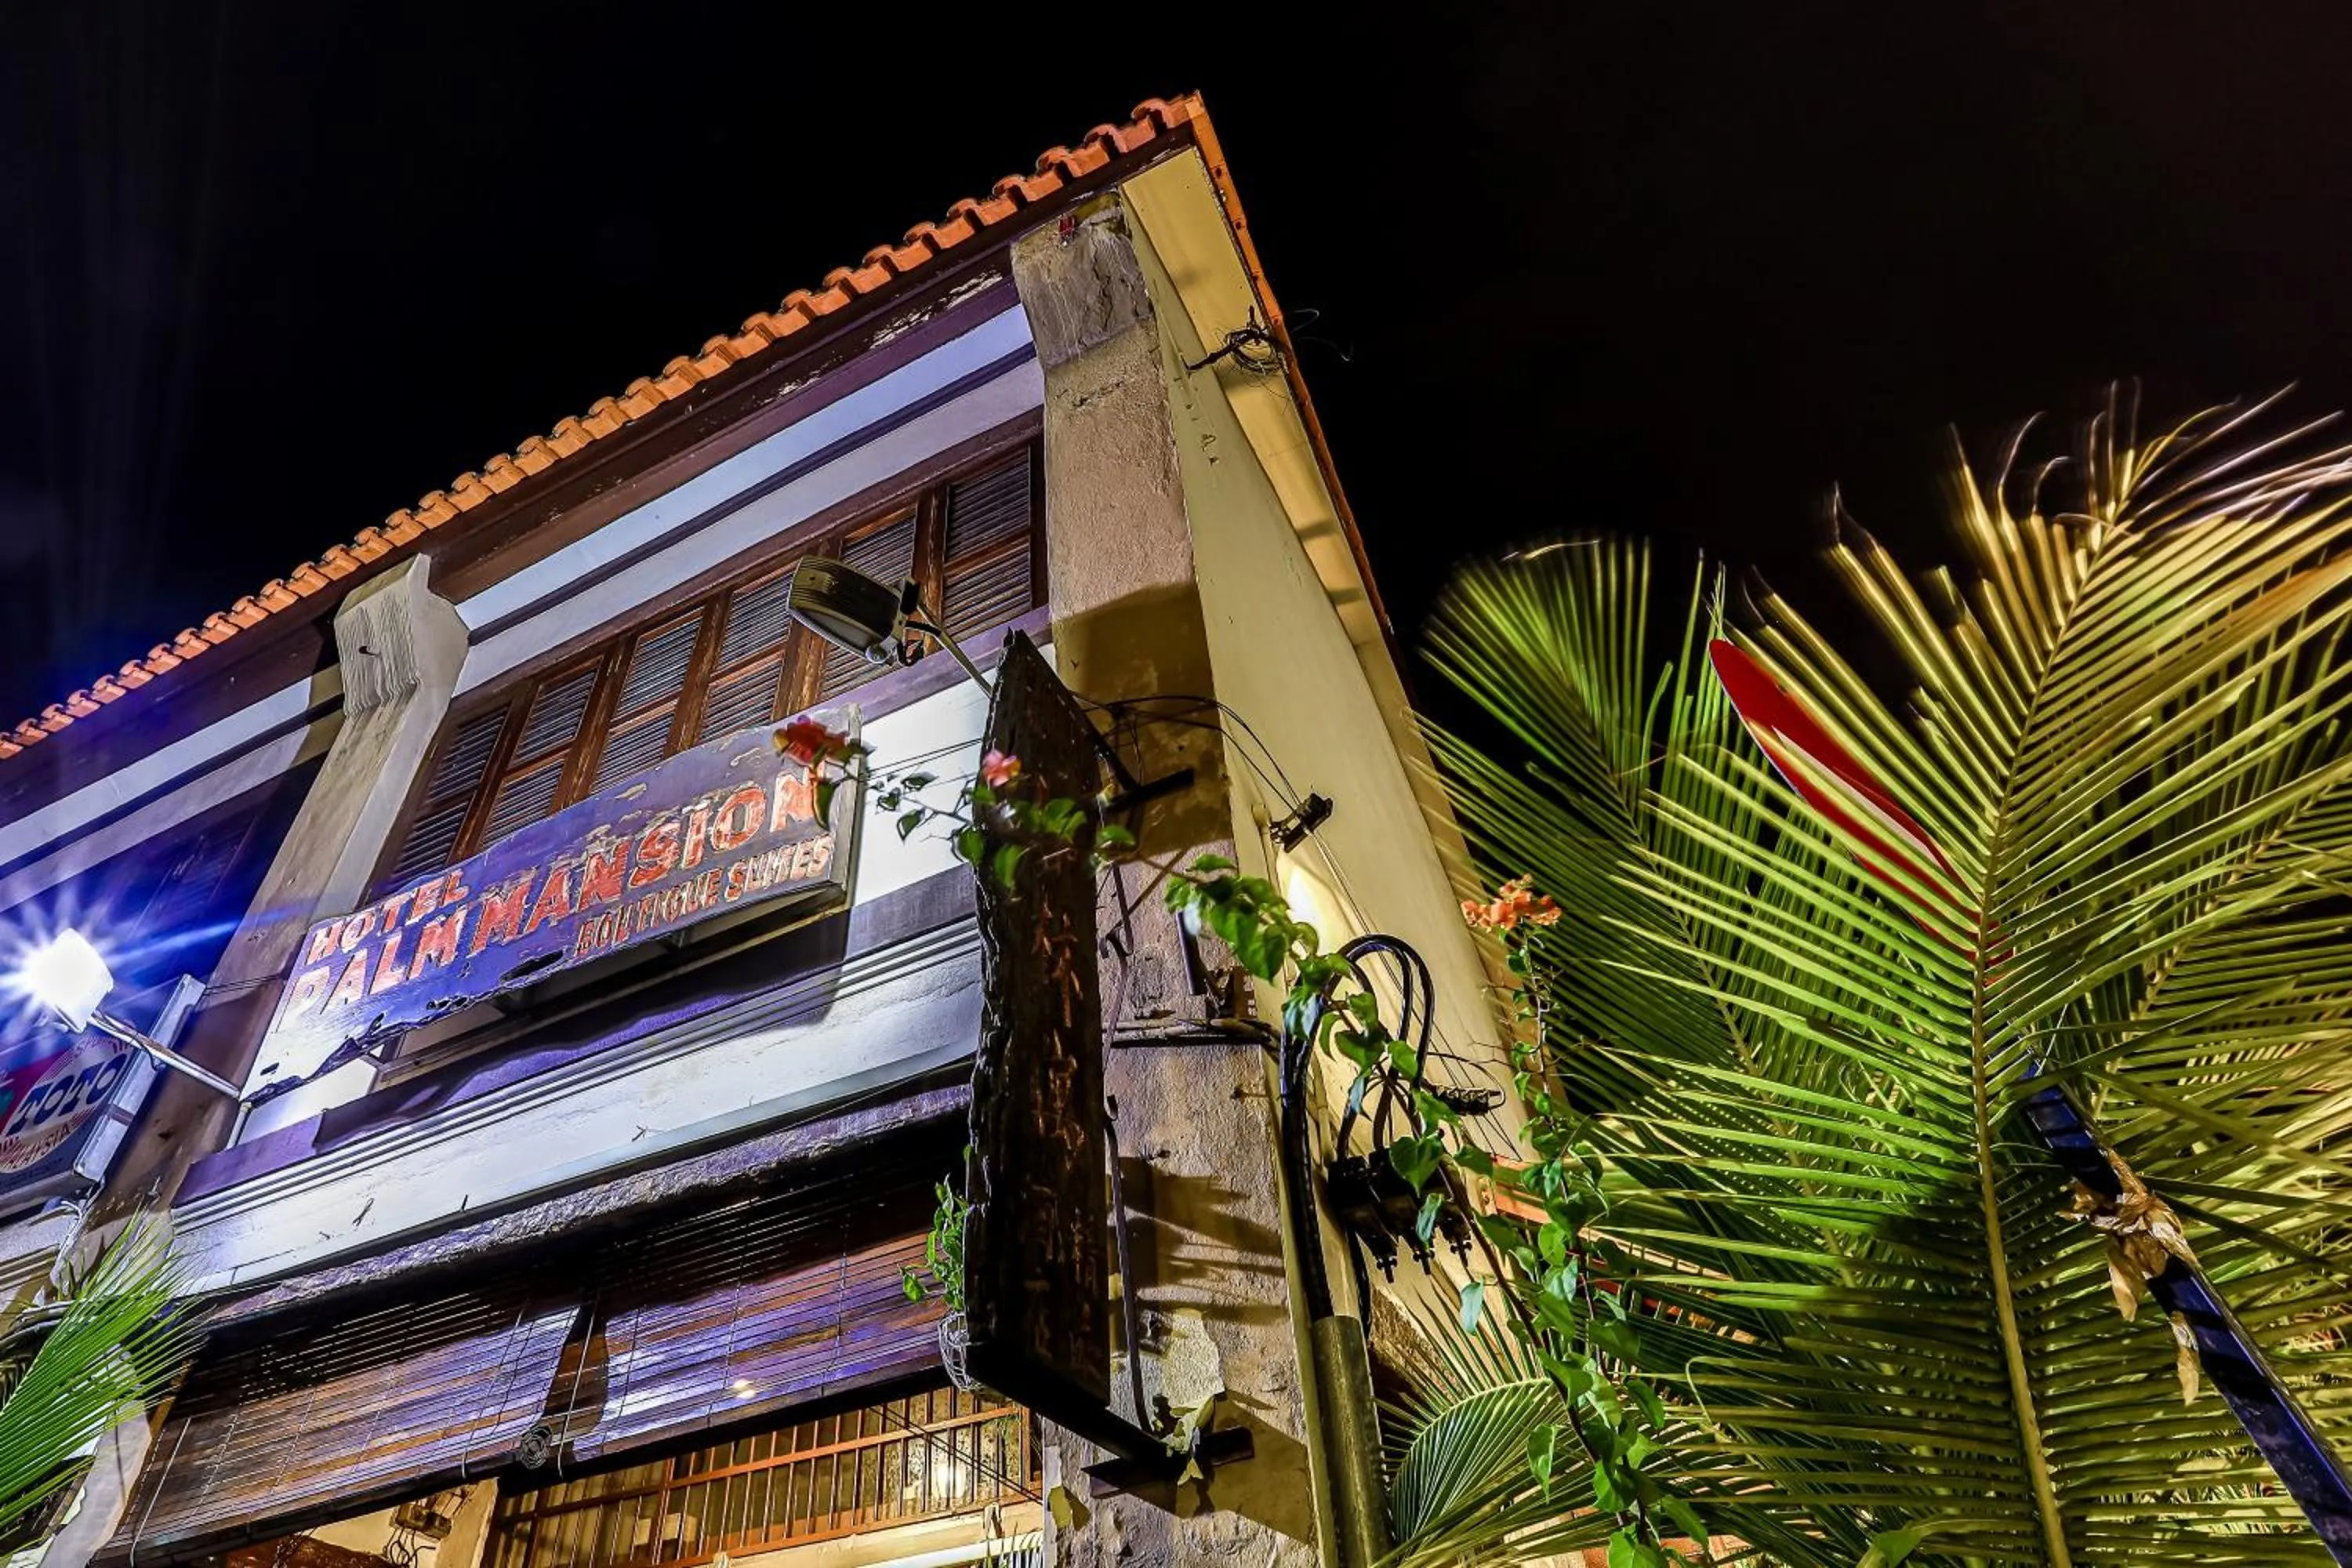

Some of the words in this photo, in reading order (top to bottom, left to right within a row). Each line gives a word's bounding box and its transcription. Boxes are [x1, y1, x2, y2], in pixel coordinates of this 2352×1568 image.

[277, 904, 469, 1029] PALM
[470, 763, 824, 956] MANSION
[723, 831, 835, 903] SUITES
[304, 868, 470, 966] HOTEL
[5, 1052, 128, 1137] TOTO
